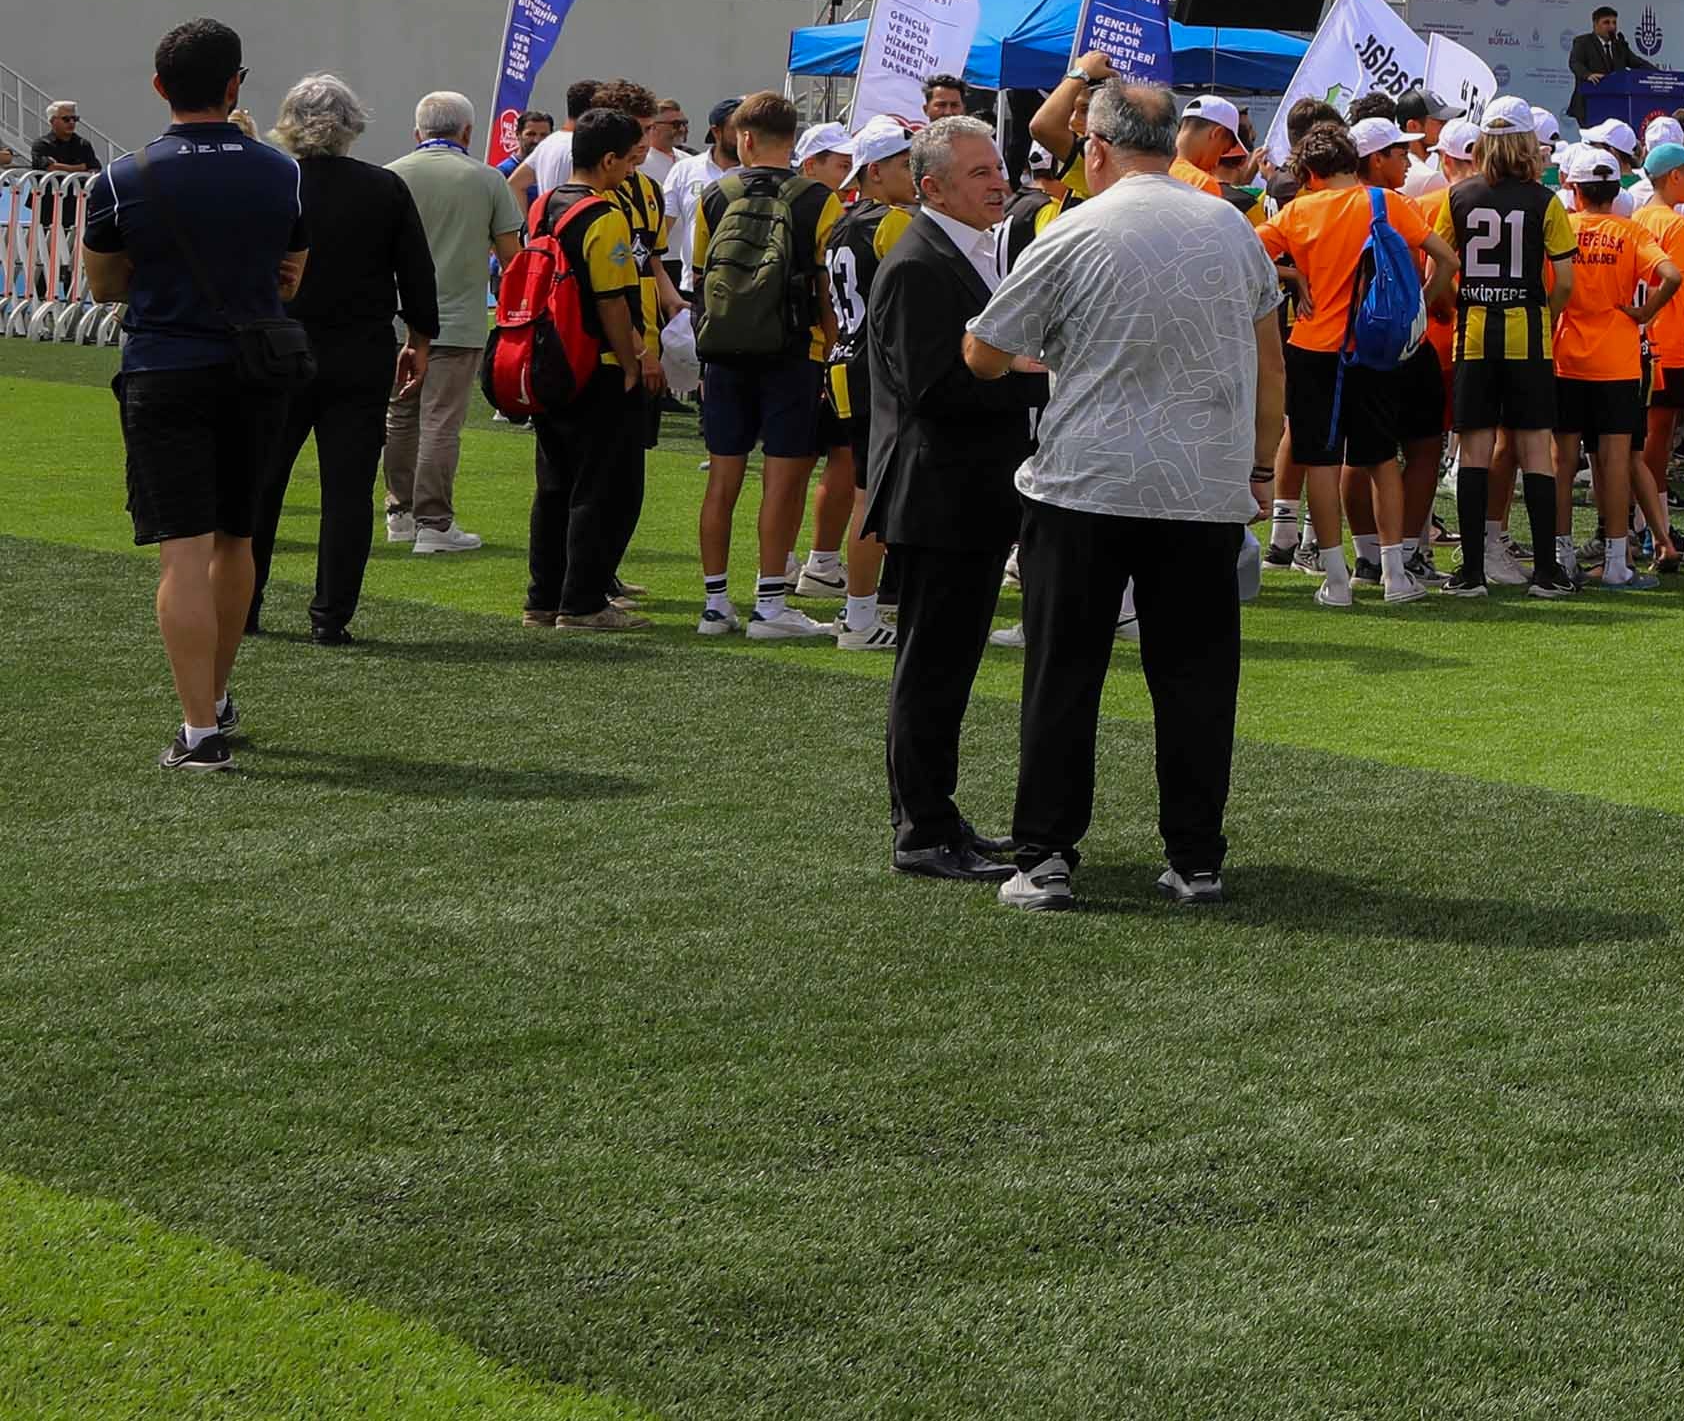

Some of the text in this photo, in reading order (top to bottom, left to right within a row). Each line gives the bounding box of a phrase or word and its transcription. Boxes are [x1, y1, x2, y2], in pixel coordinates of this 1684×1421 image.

[888, 22, 903, 36] VE
[1092, 27, 1140, 48] VE SPOR
[1095, 14, 1143, 37] GENÇLİK
[883, 45, 923, 71] DAİRESİ
[1089, 38, 1155, 66] HİZMETLERİ
[1465, 207, 1525, 279] 21
